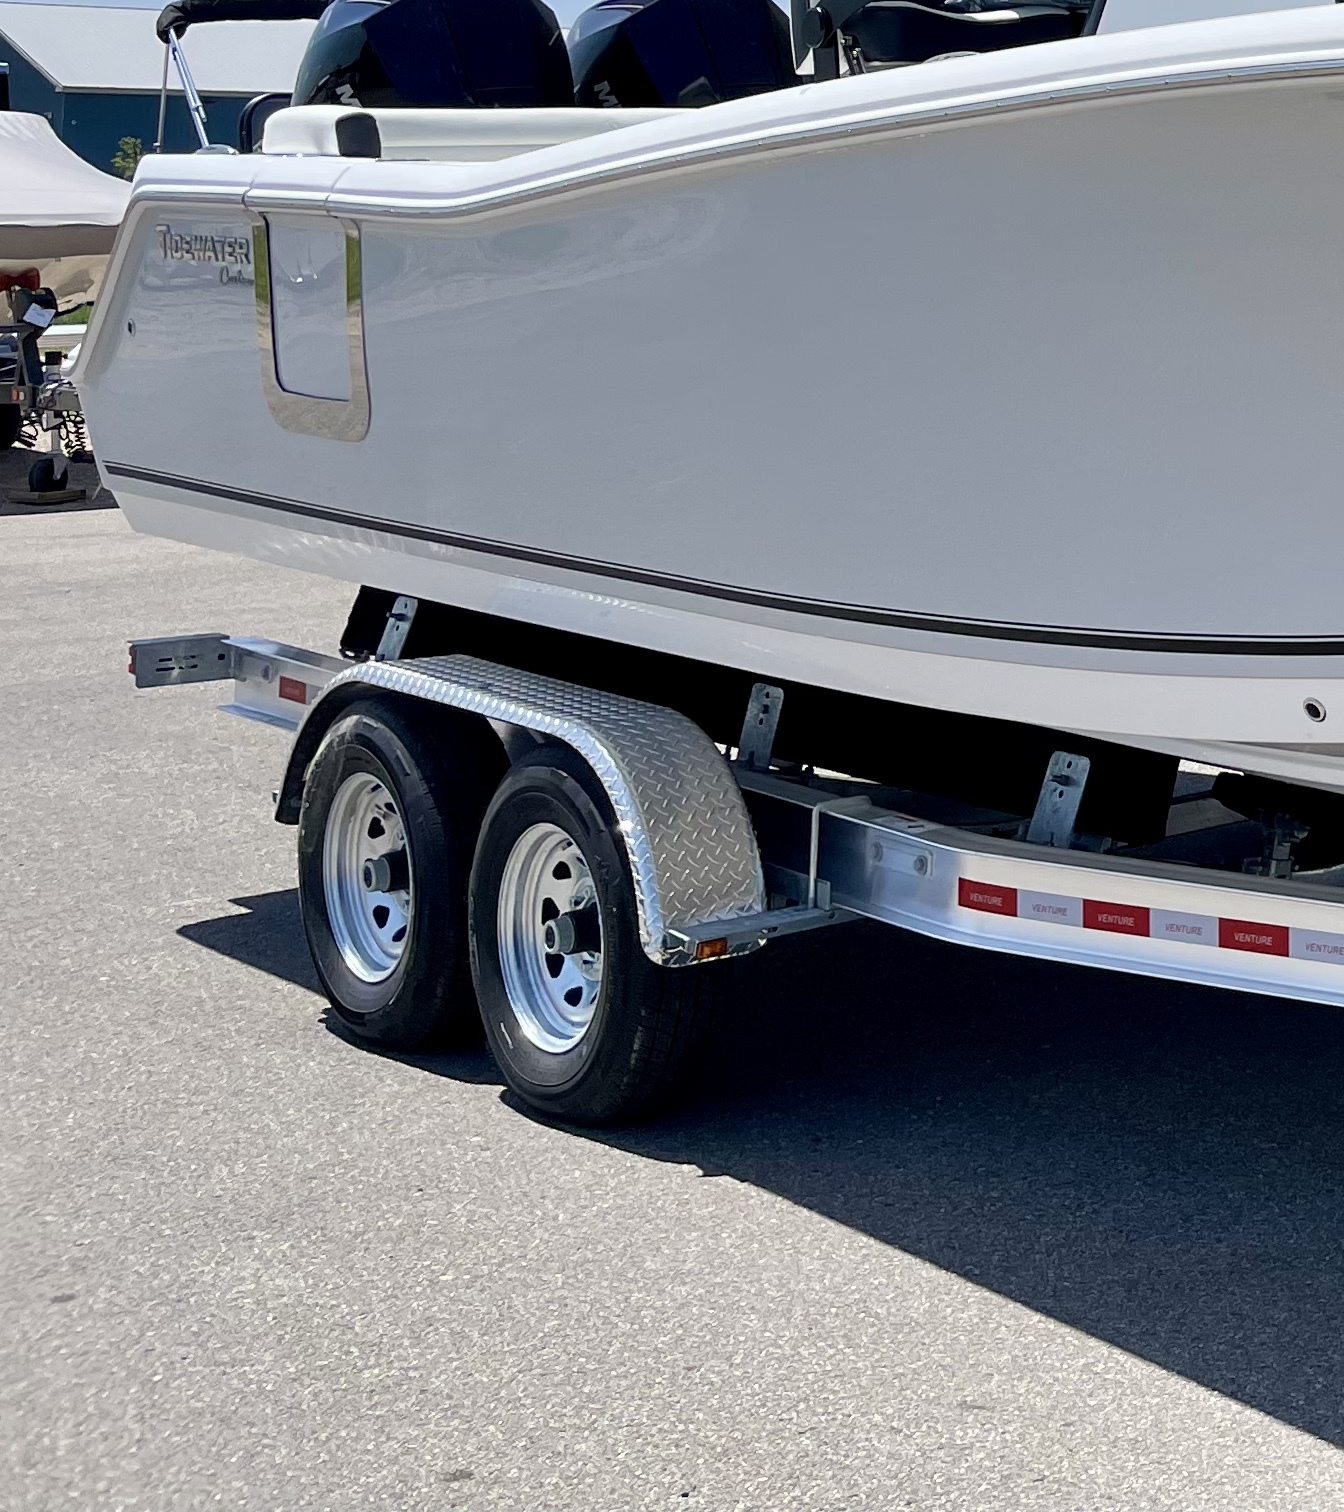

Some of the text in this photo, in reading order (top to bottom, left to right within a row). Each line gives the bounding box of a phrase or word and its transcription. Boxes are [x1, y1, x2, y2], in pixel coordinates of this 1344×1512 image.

[969, 892, 1002, 906] VENTURE
[1032, 903, 1067, 916] VENTURE
[1098, 913, 1134, 926] VENTURE
[1165, 922, 1203, 936] VENTURE
[1234, 932, 1273, 946] VENTURE
[1305, 942, 1344, 956] VENTURE
